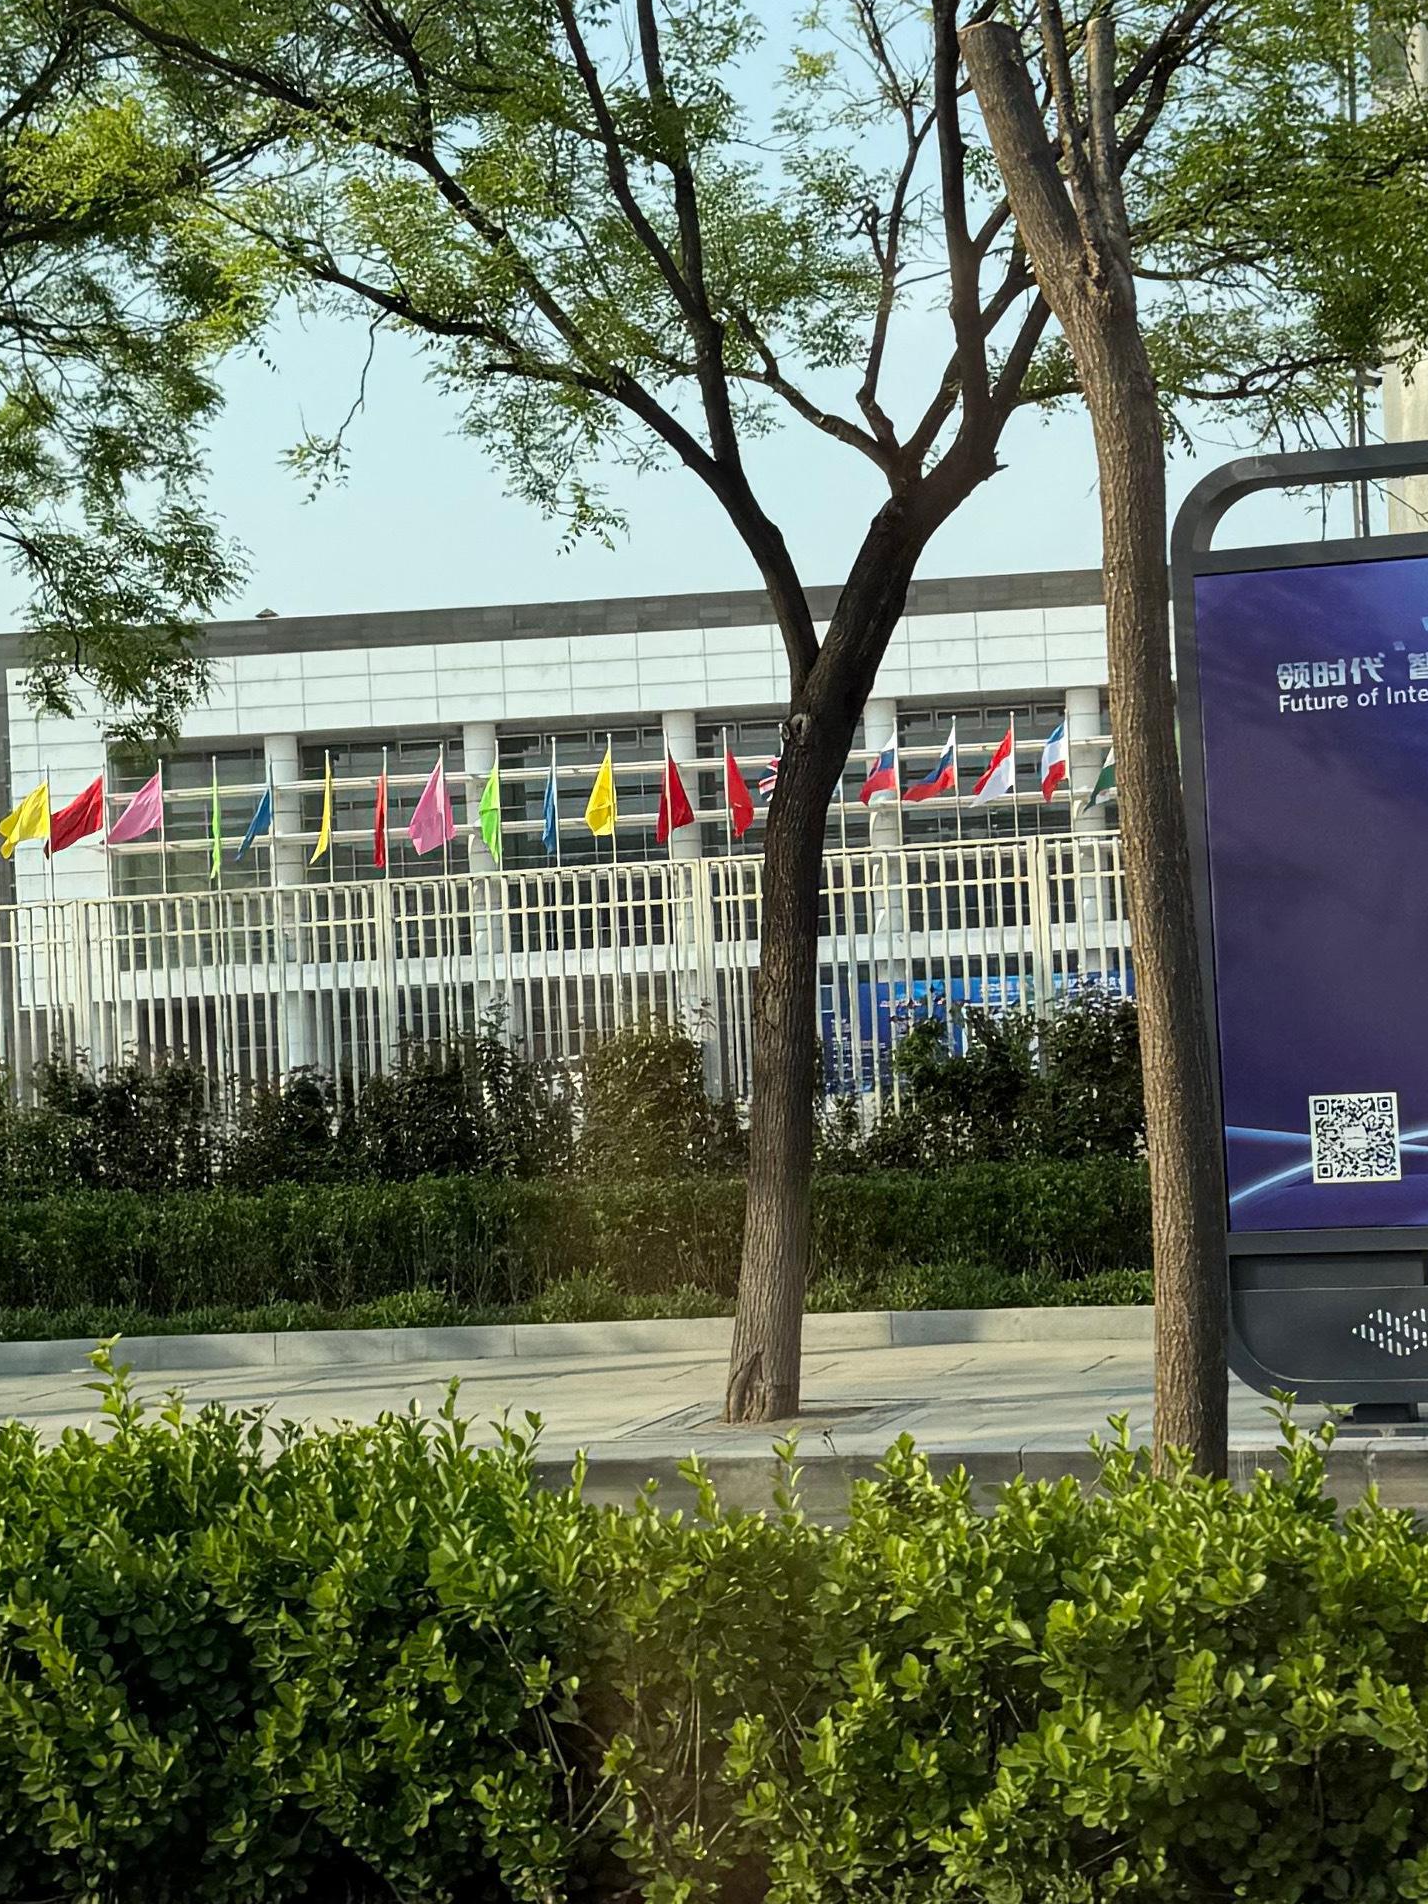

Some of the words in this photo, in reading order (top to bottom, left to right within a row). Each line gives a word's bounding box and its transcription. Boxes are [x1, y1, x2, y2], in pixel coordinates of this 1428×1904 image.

[1276, 653, 1386, 691] 领时代
[1278, 693, 1349, 713] Future
[1357, 687, 1379, 707] of
